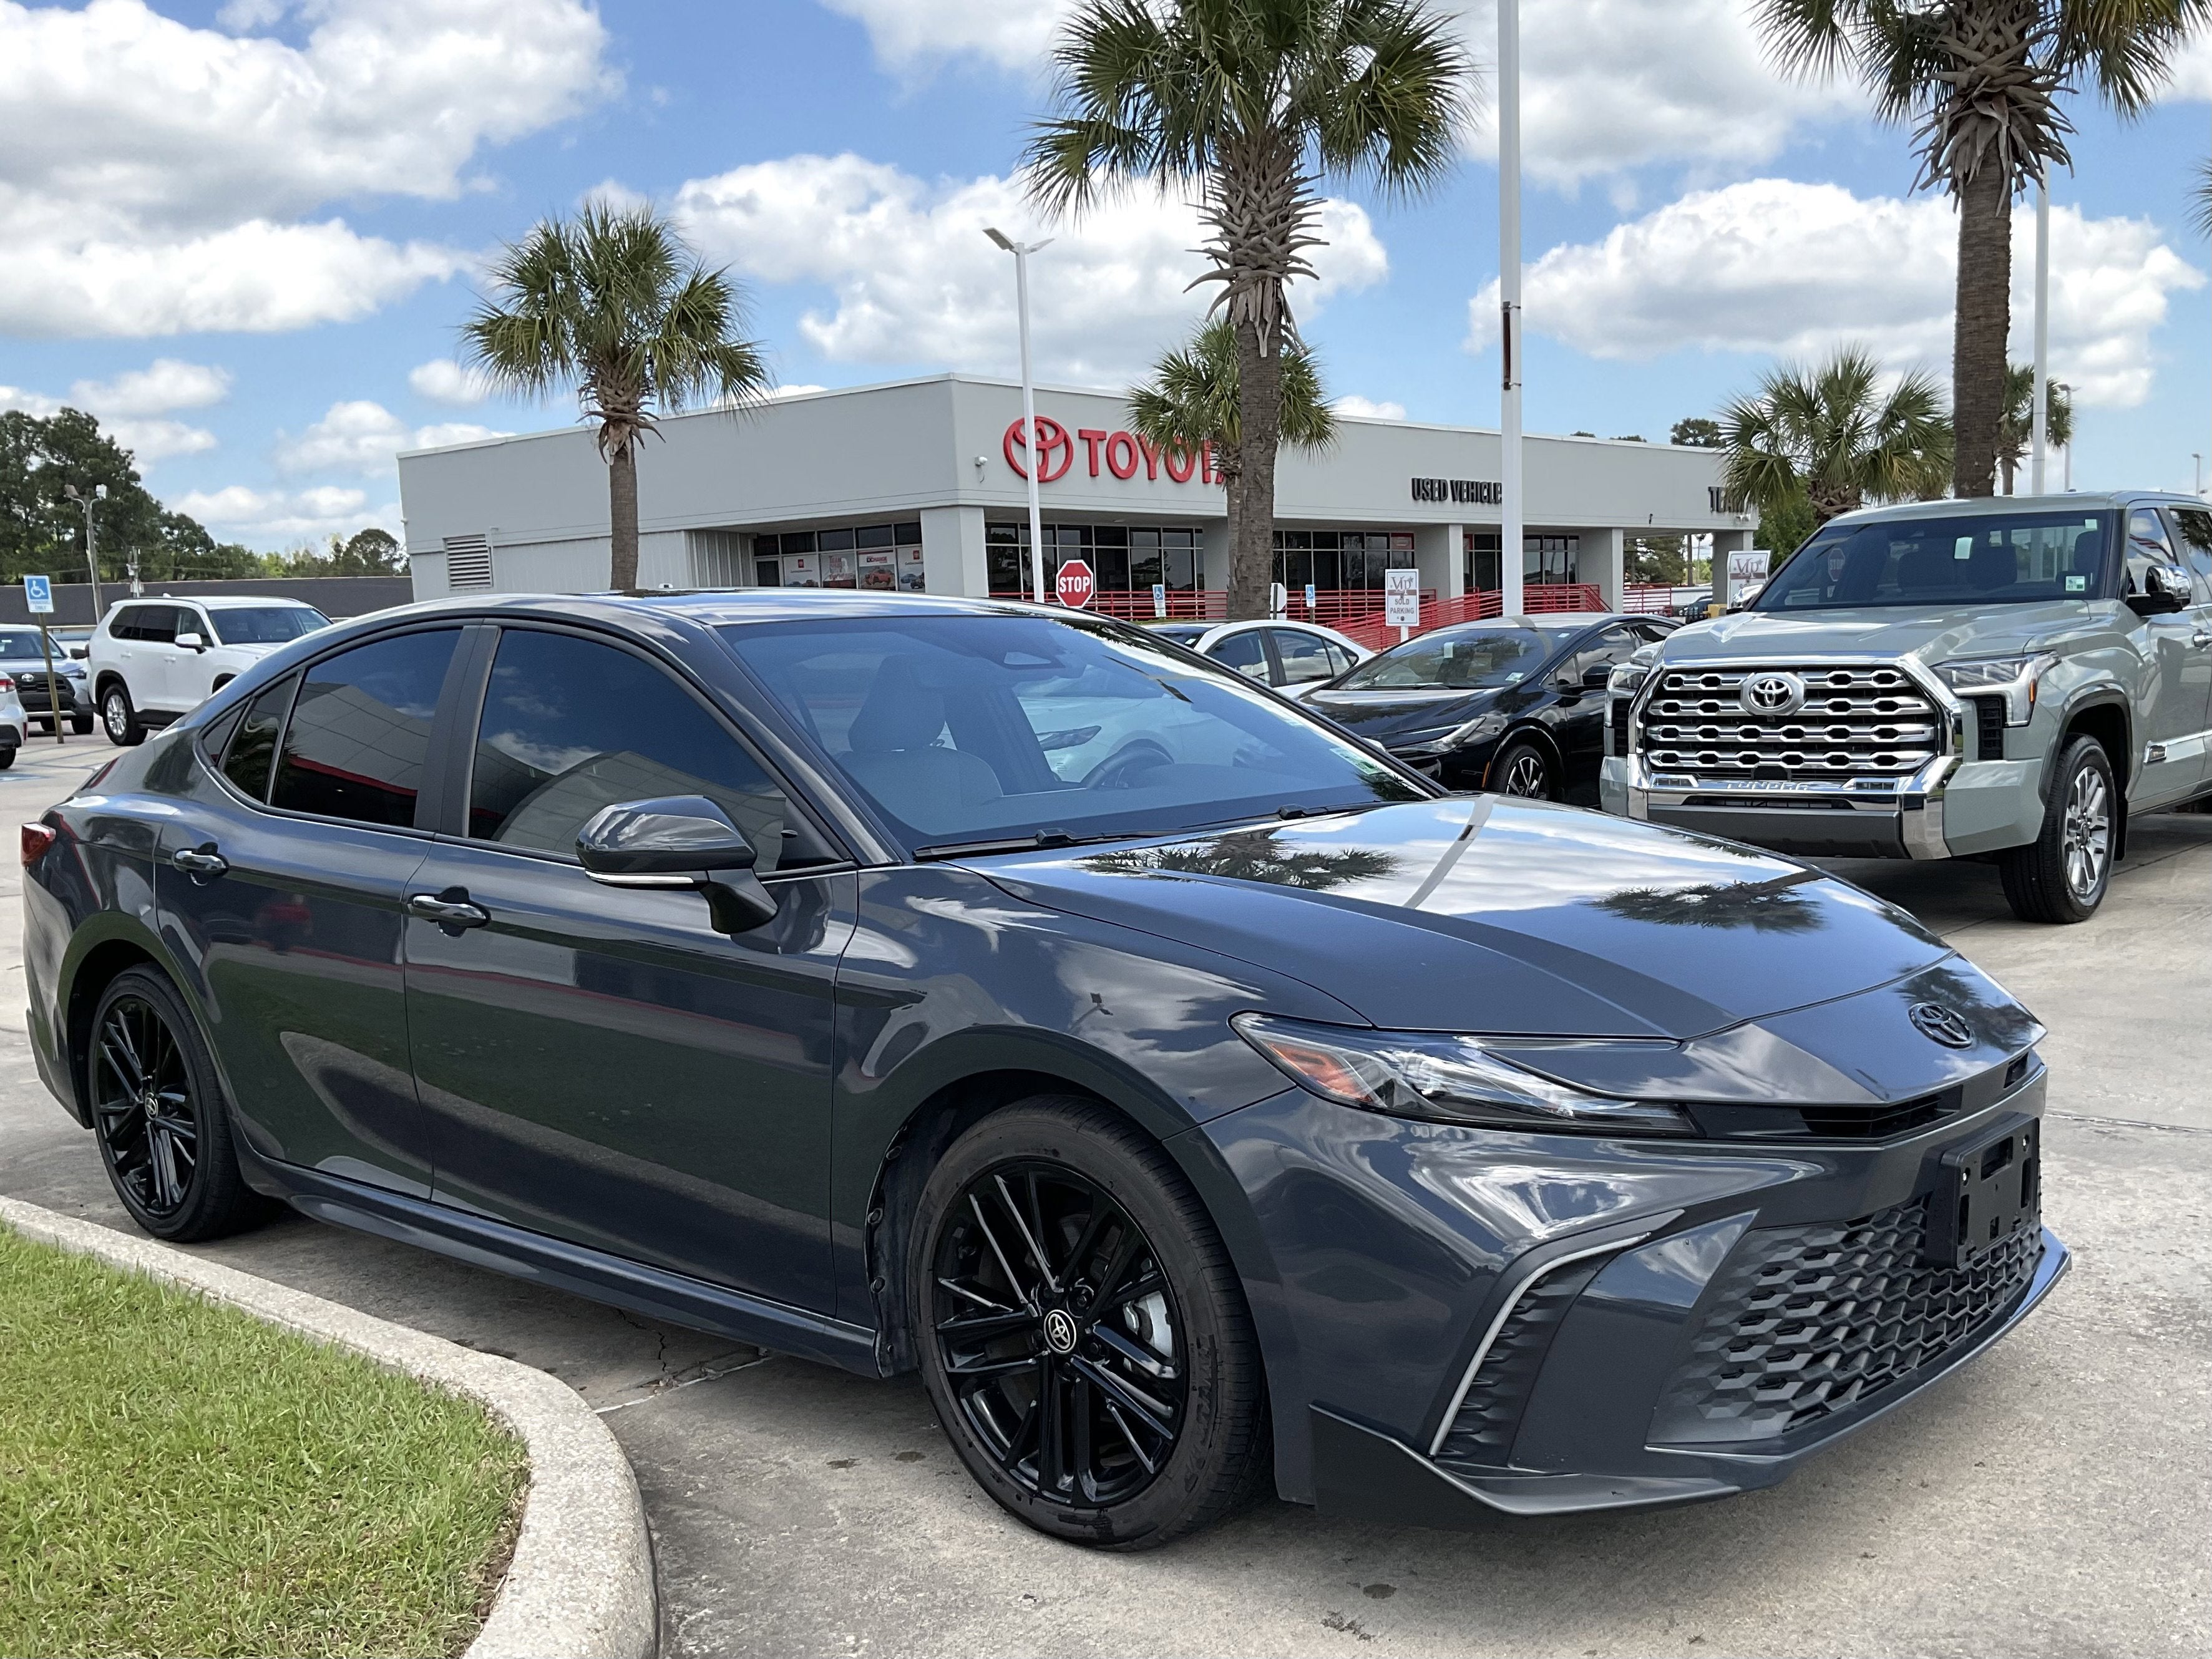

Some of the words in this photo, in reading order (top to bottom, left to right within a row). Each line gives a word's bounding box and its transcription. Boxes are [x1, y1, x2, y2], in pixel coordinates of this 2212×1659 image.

[1078, 429, 1224, 484] TOYOT
[1411, 477, 1448, 501] USED
[1060, 576, 1090, 593] STOP
